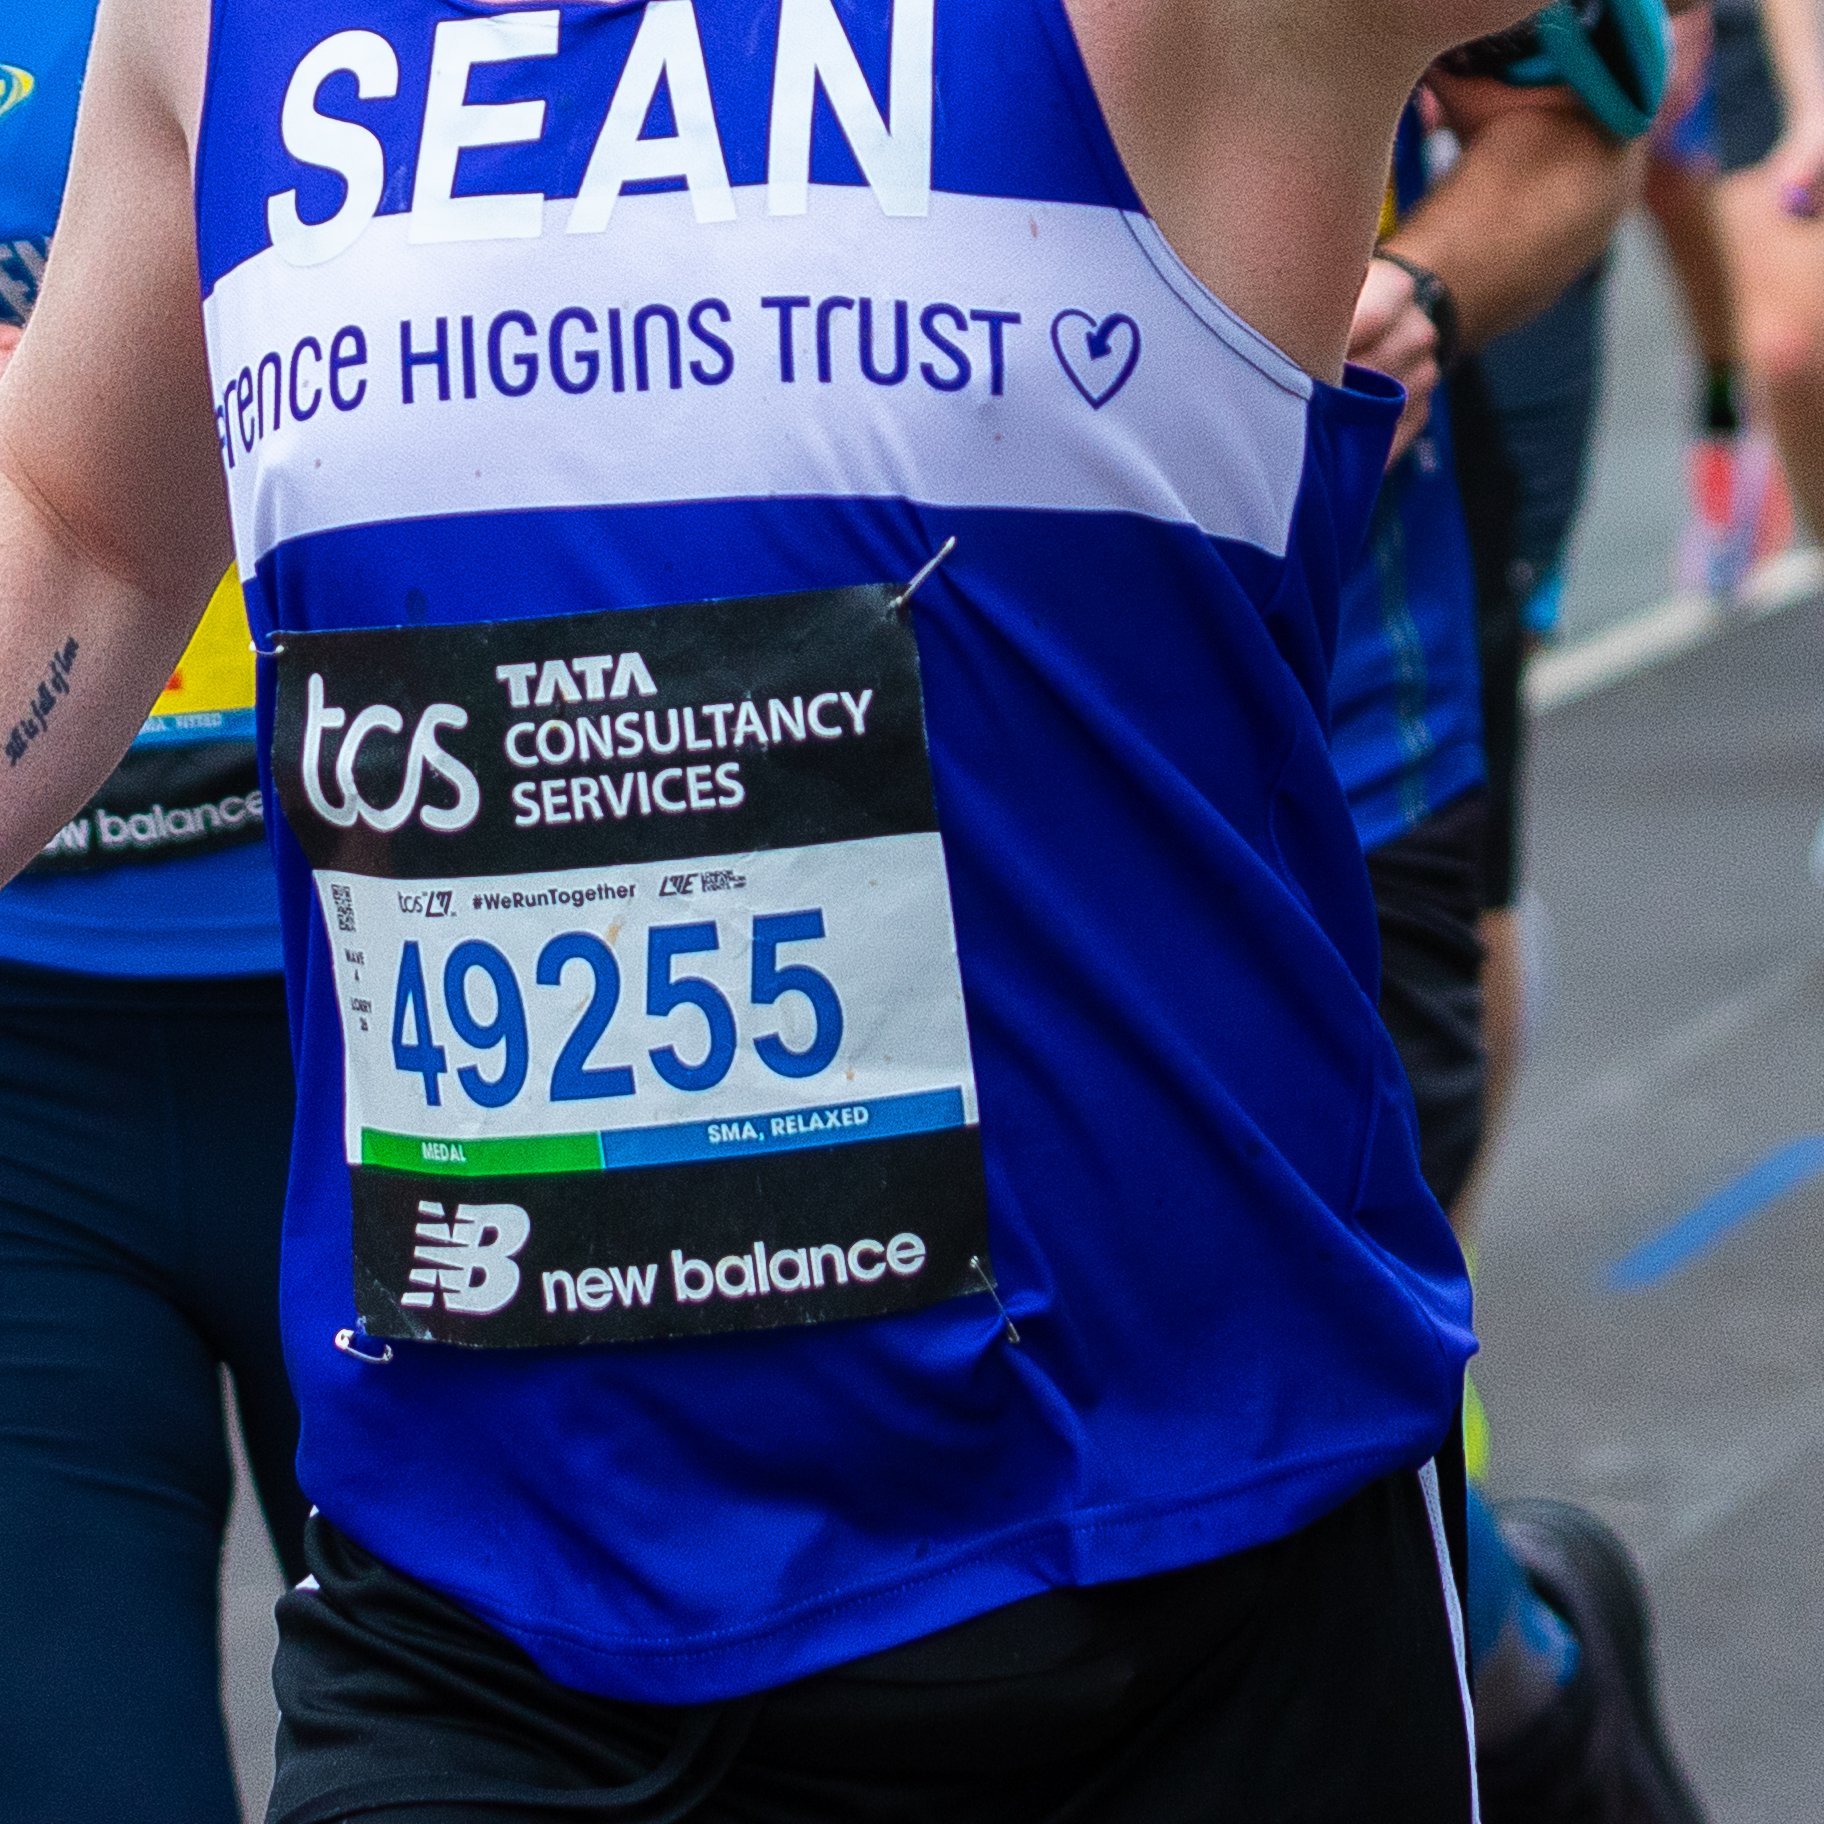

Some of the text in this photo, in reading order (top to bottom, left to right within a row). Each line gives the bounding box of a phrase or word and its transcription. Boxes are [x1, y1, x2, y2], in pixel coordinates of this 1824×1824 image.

[496, 652, 658, 707] TATA
[301, 672, 481, 832] tcs
[504, 688, 876, 768] CONSULTANCY
[95, 789, 264, 847] balance
[511, 760, 746, 828] SERVICES
[472, 883, 637, 911] #WeRunTogether
[390, 907, 845, 1110] 49255
[421, 1141, 467, 1163] MEDAL
[707, 1106, 870, 1145] SMA, RELAXED
[540, 1229, 928, 1314] new balance
